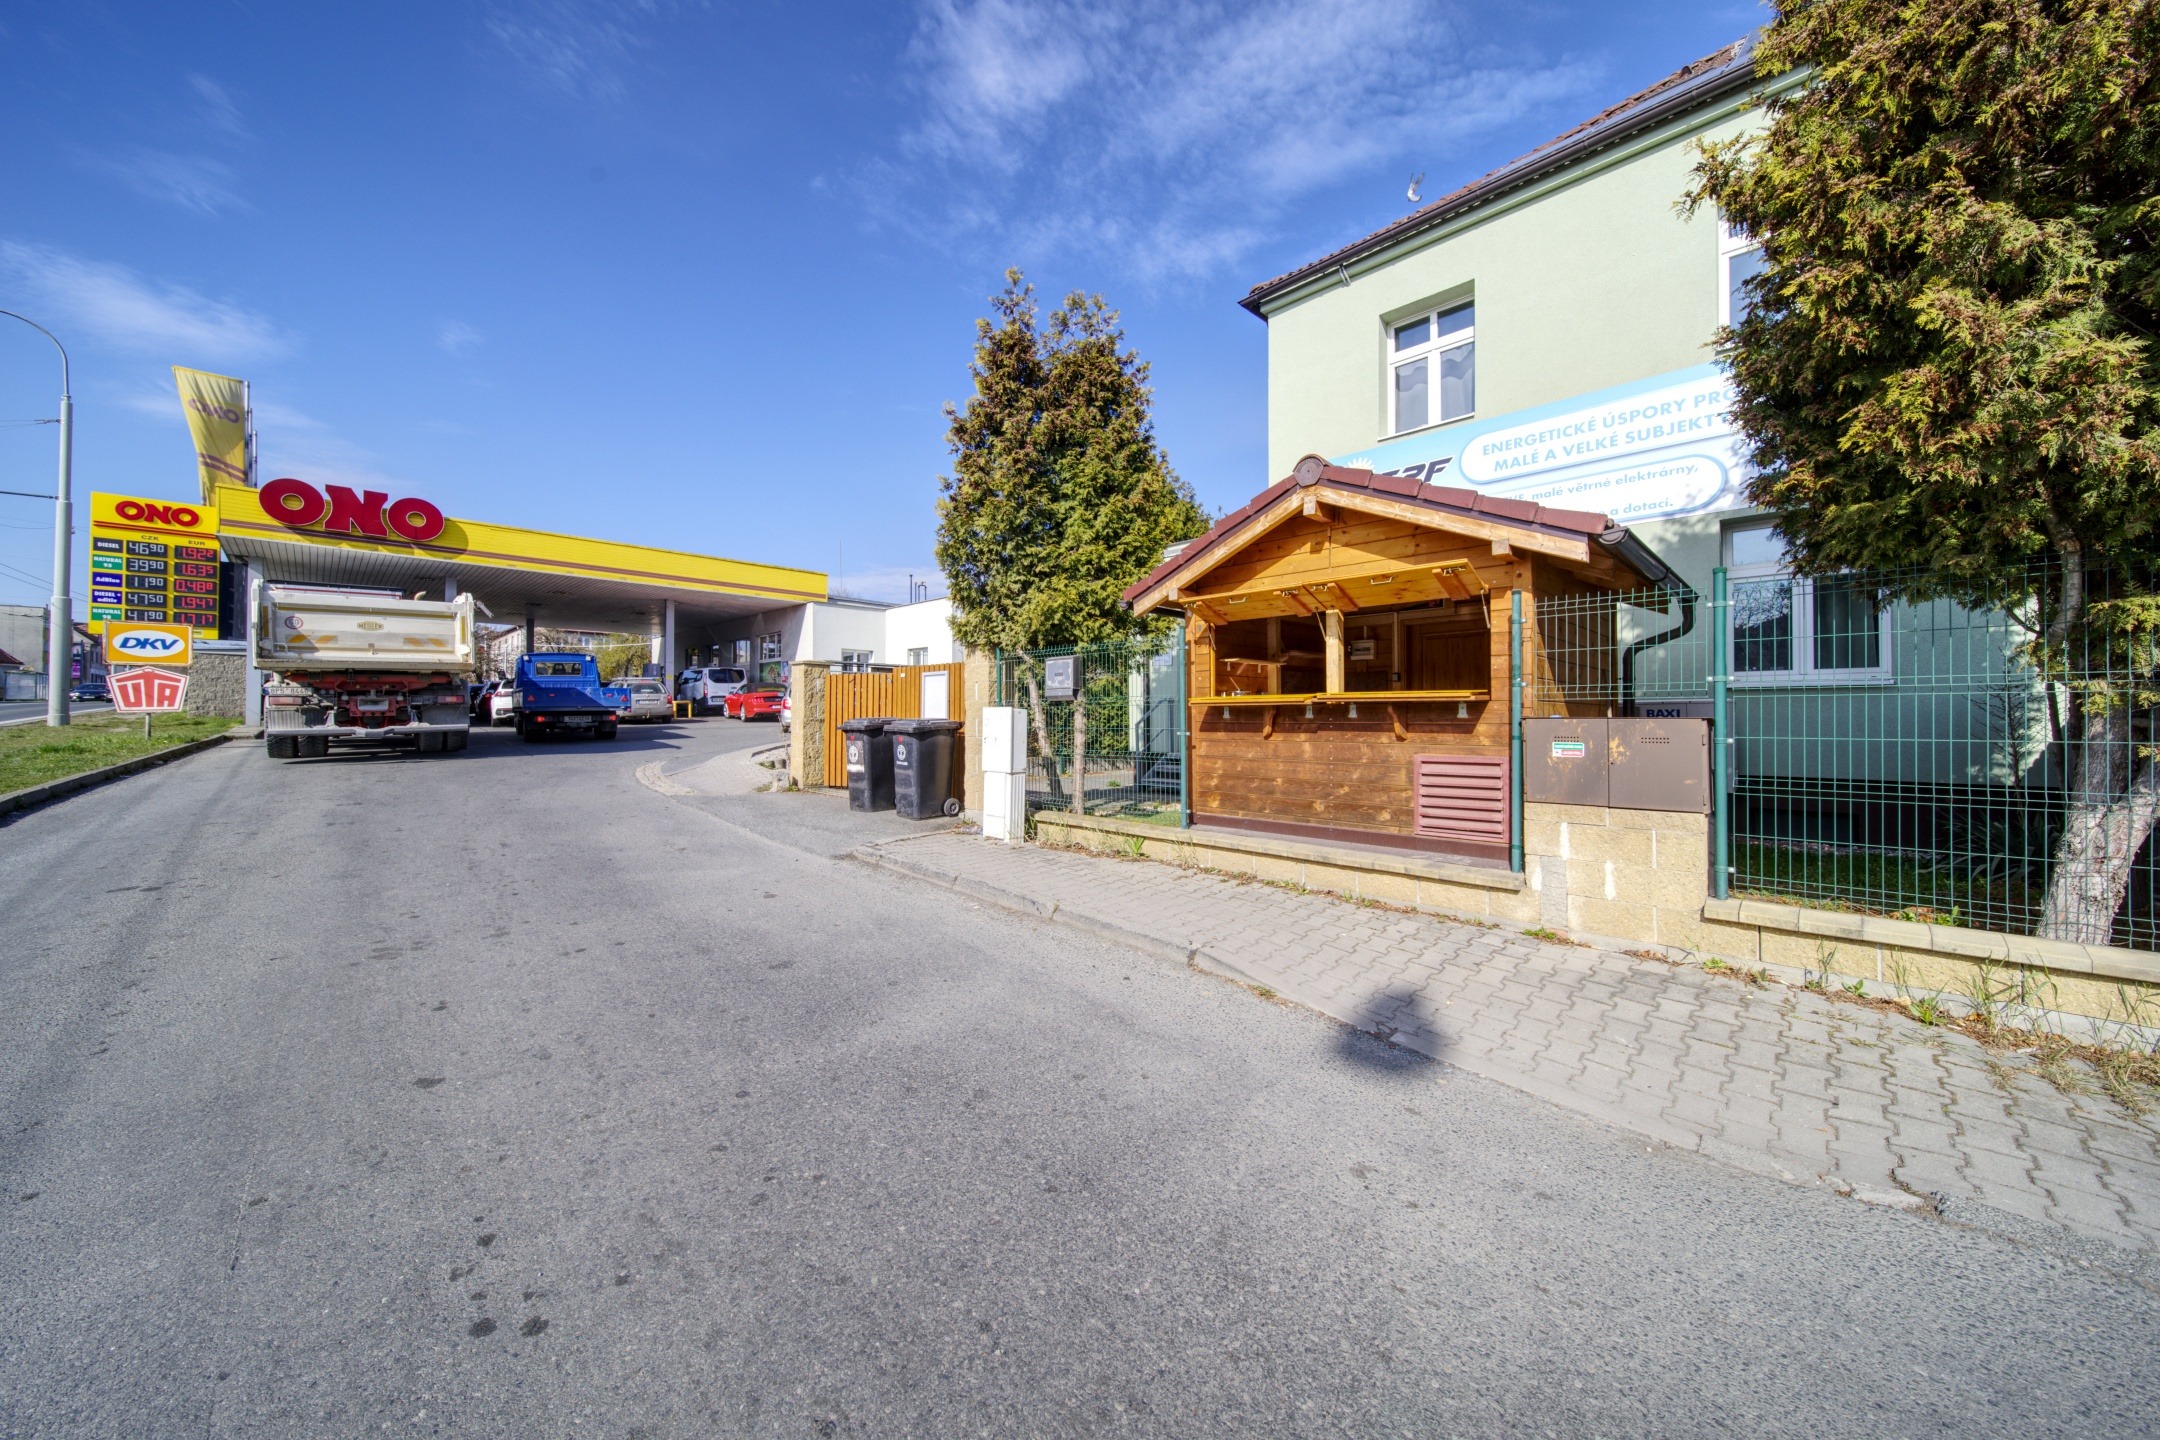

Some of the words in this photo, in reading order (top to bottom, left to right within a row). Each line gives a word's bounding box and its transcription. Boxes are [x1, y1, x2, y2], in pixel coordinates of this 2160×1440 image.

[187, 398, 240, 424] ONO
[1482, 415, 1597, 456] ENERGETICKÉ
[1602, 397, 1687, 429] ÚSPORY
[1494, 448, 1539, 472] MALÉ
[1544, 448, 1557, 461] A
[1562, 430, 1619, 457] VELKÉ
[1532, 486, 1563, 500] malé
[1567, 477, 1611, 494] větrné
[1615, 464, 1698, 485] elektrárny,
[115, 500, 200, 527] ONO
[258, 478, 445, 541] ONO
[1623, 497, 1673, 514] dotací.
[97, 541, 120, 549] DIESEL
[93, 555, 122, 564] NATURAL
[118, 637, 180, 650] DKV
[115, 671, 182, 708] UTA
[1646, 709, 1681, 718] BAXI
